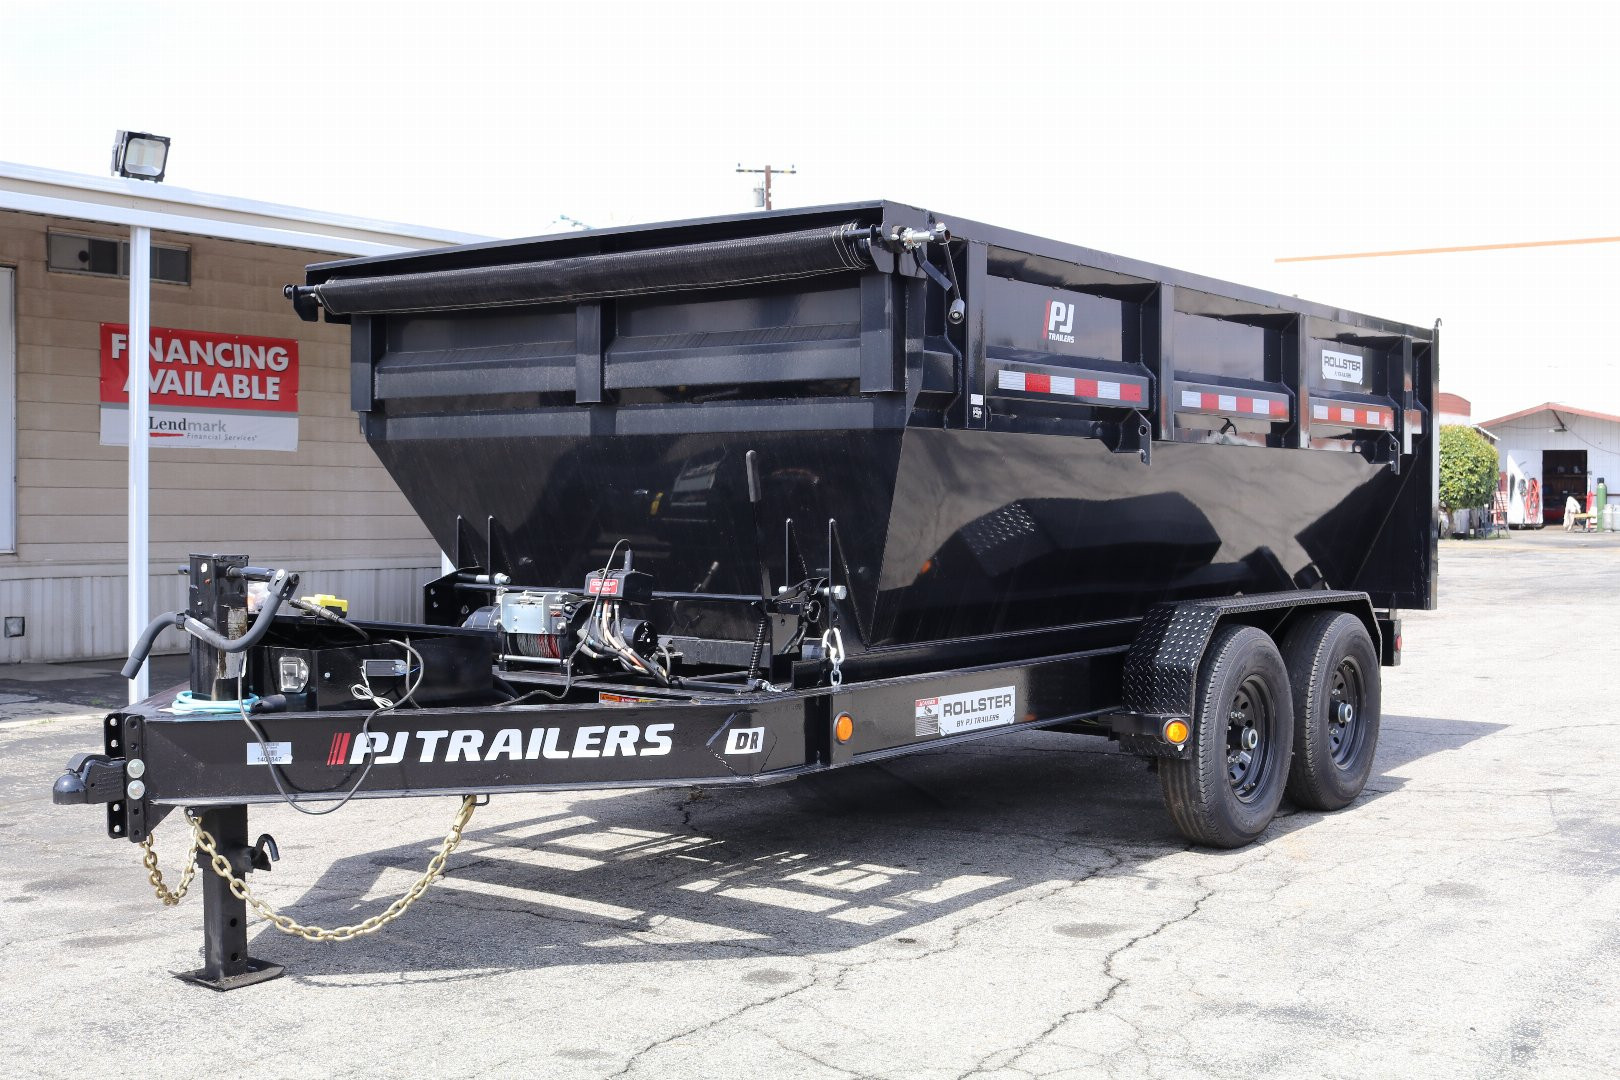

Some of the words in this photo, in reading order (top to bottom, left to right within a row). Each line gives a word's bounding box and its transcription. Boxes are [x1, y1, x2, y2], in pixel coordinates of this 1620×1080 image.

[1048, 300, 1075, 333] PJ
[1048, 332, 1075, 344] TRAILERS
[111, 333, 289, 372] FNANCING
[1323, 356, 1361, 371] ROLLSTER
[149, 416, 227, 433] Lendmark
[186, 432, 222, 441] Financial
[223, 433, 257, 442] Services
[943, 693, 1012, 717] ROLLSTER
[965, 718, 973, 726] PJ
[974, 713, 1000, 724] TRAILERS
[348, 731, 410, 765] PJ
[416, 723, 675, 763] TRAILERS
[734, 731, 759, 750] DR
